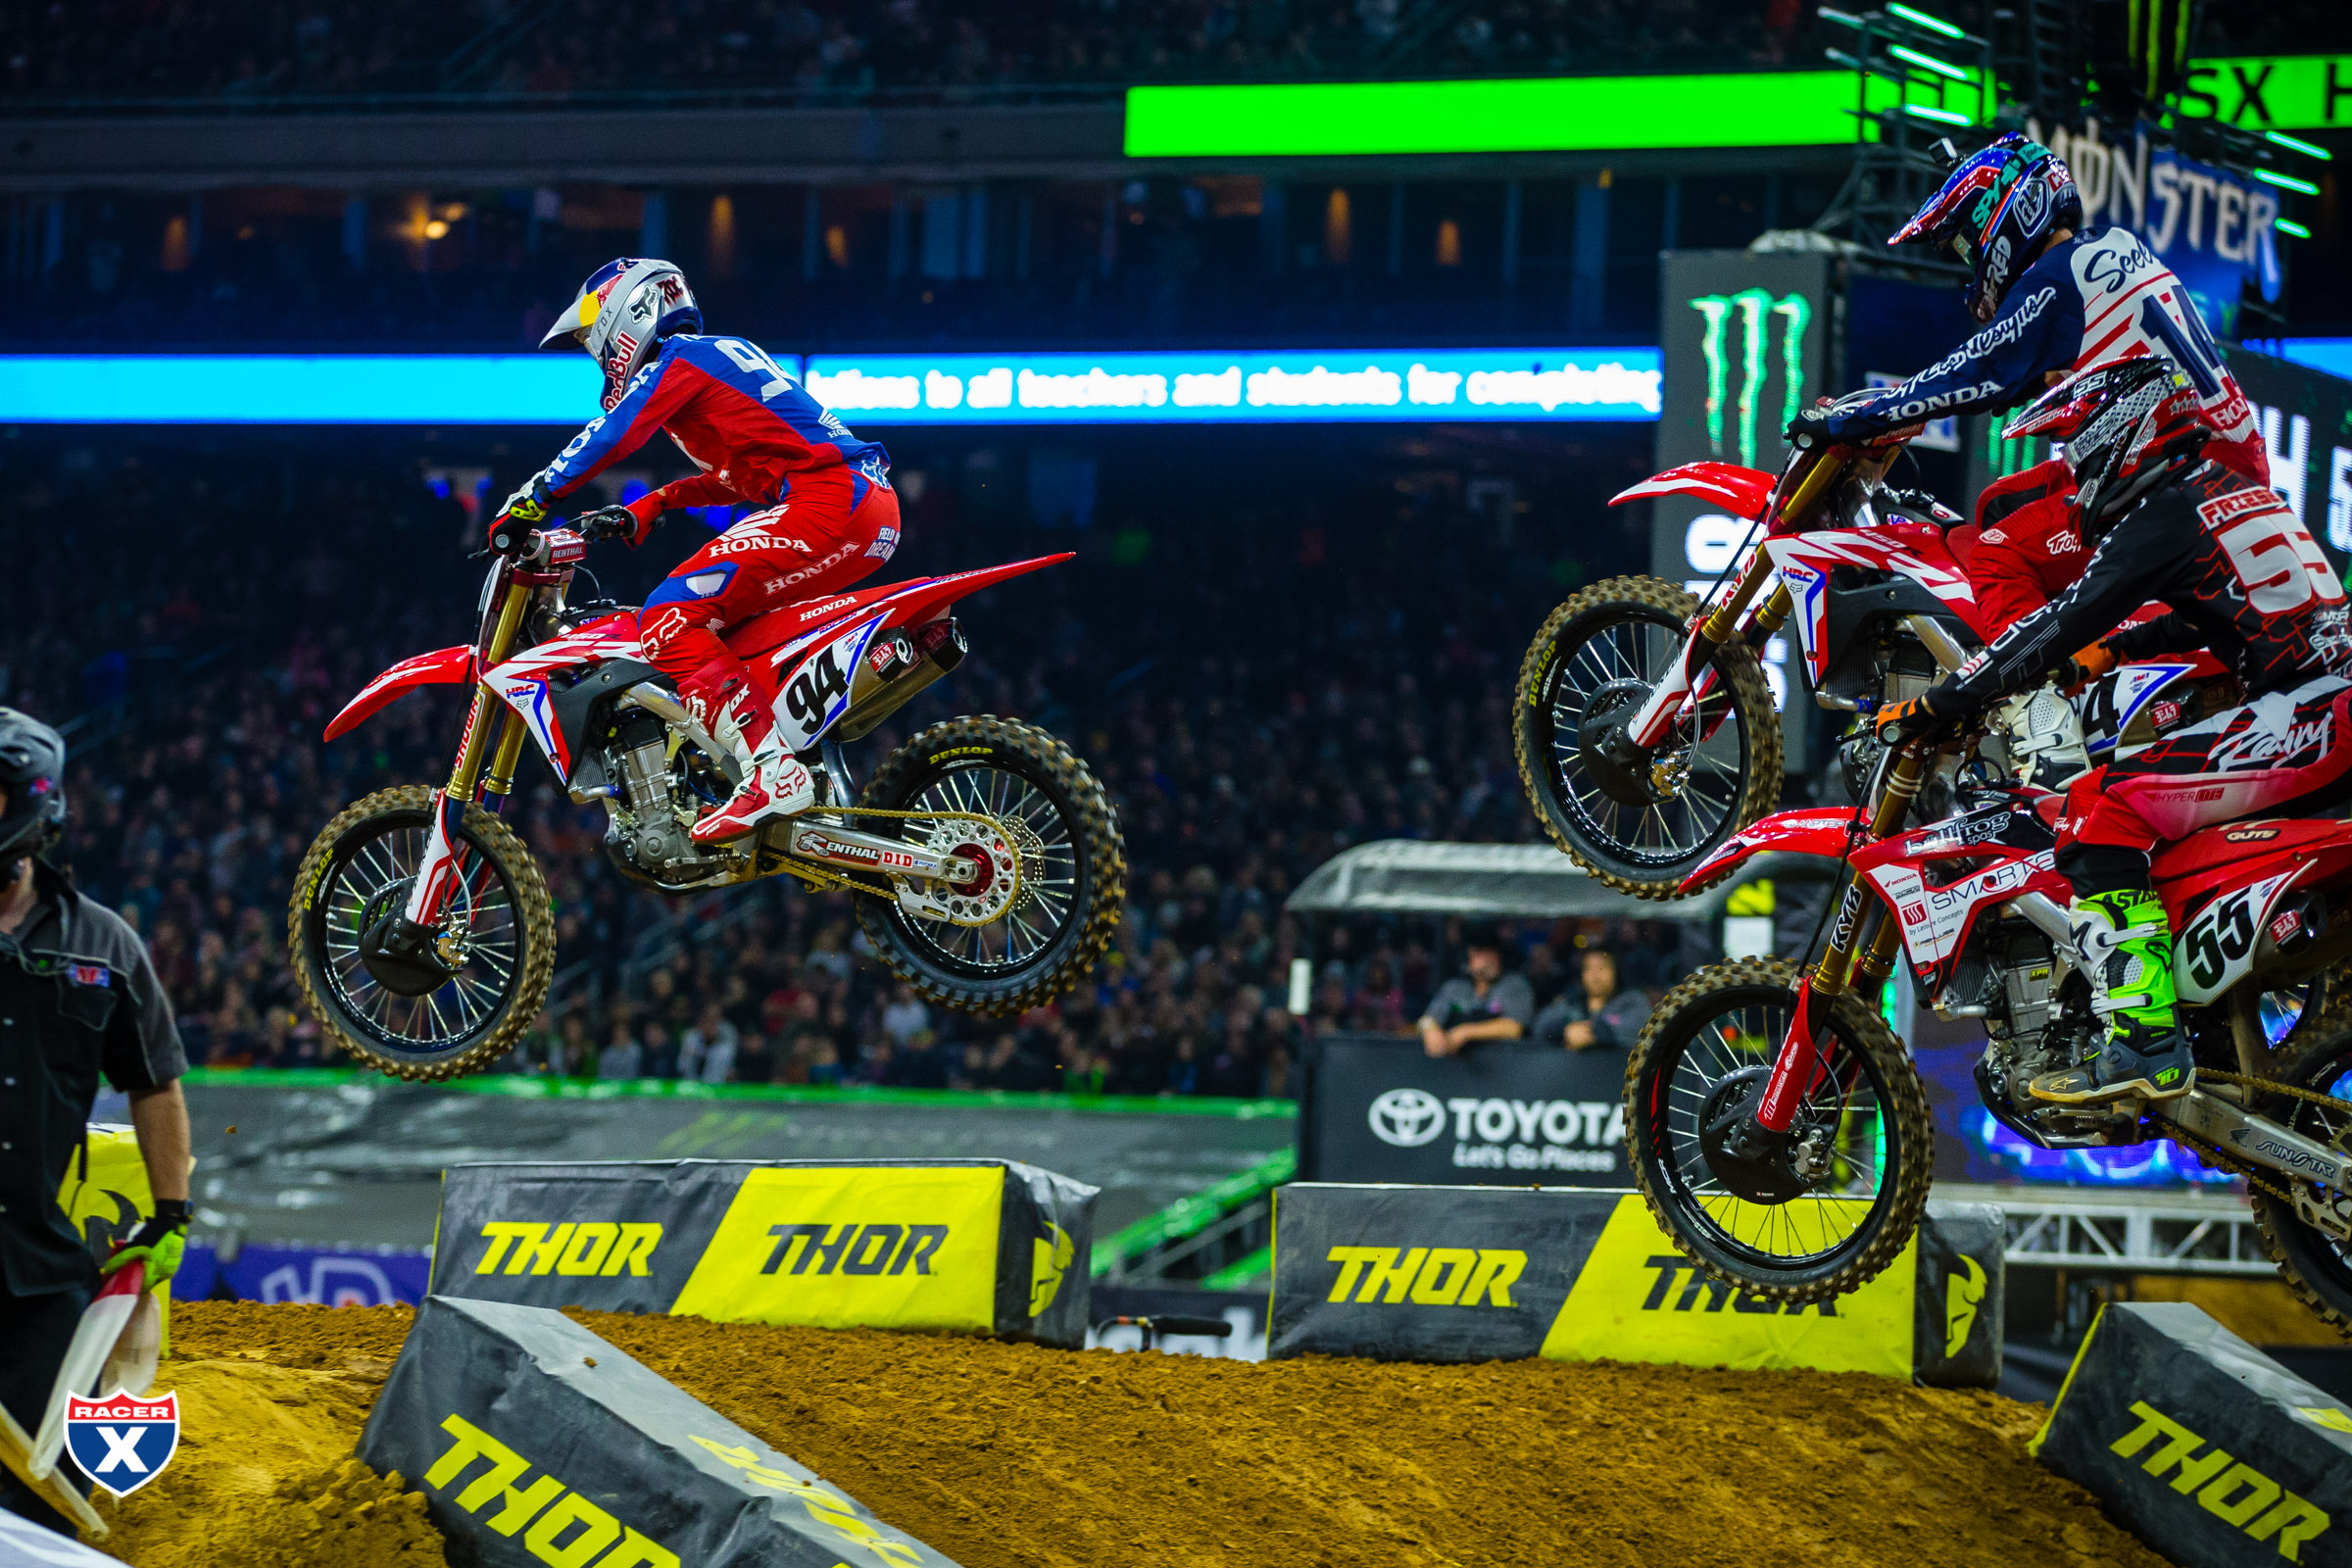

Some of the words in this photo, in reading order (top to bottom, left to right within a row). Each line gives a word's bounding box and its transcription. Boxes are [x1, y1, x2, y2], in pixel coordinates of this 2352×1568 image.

[596, 307, 614, 337] FOX
[1881, 379, 2005, 422] HONDA
[552, 545, 584, 560] RENTHAL
[709, 535, 812, 559] HONDA
[764, 541, 859, 595] HONDA
[1782, 564, 1815, 584] HRC
[799, 596, 858, 622] HONDA
[505, 683, 536, 700] HRC
[785, 645, 851, 736] 94
[455, 696, 480, 771] SHOWA
[928, 745, 994, 765] DUNLOP
[1904, 811, 2012, 857] bullfrog
[1967, 830, 1995, 846] spas
[2227, 829, 2278, 842] GUTS
[303, 848, 334, 910] DUNLOP
[1891, 872, 1918, 886] HONDA
[1830, 883, 1863, 955] KYB
[1937, 907, 1964, 925] Concepts
[2184, 885, 2257, 990] 55
[2255, 1140, 2336, 1179] SUNSTAR
[475, 1221, 664, 1277] THOR
[760, 1223, 951, 1277] THOR
[1327, 1246, 1529, 1308] THOR
[2108, 1399, 2331, 1564] THOR
